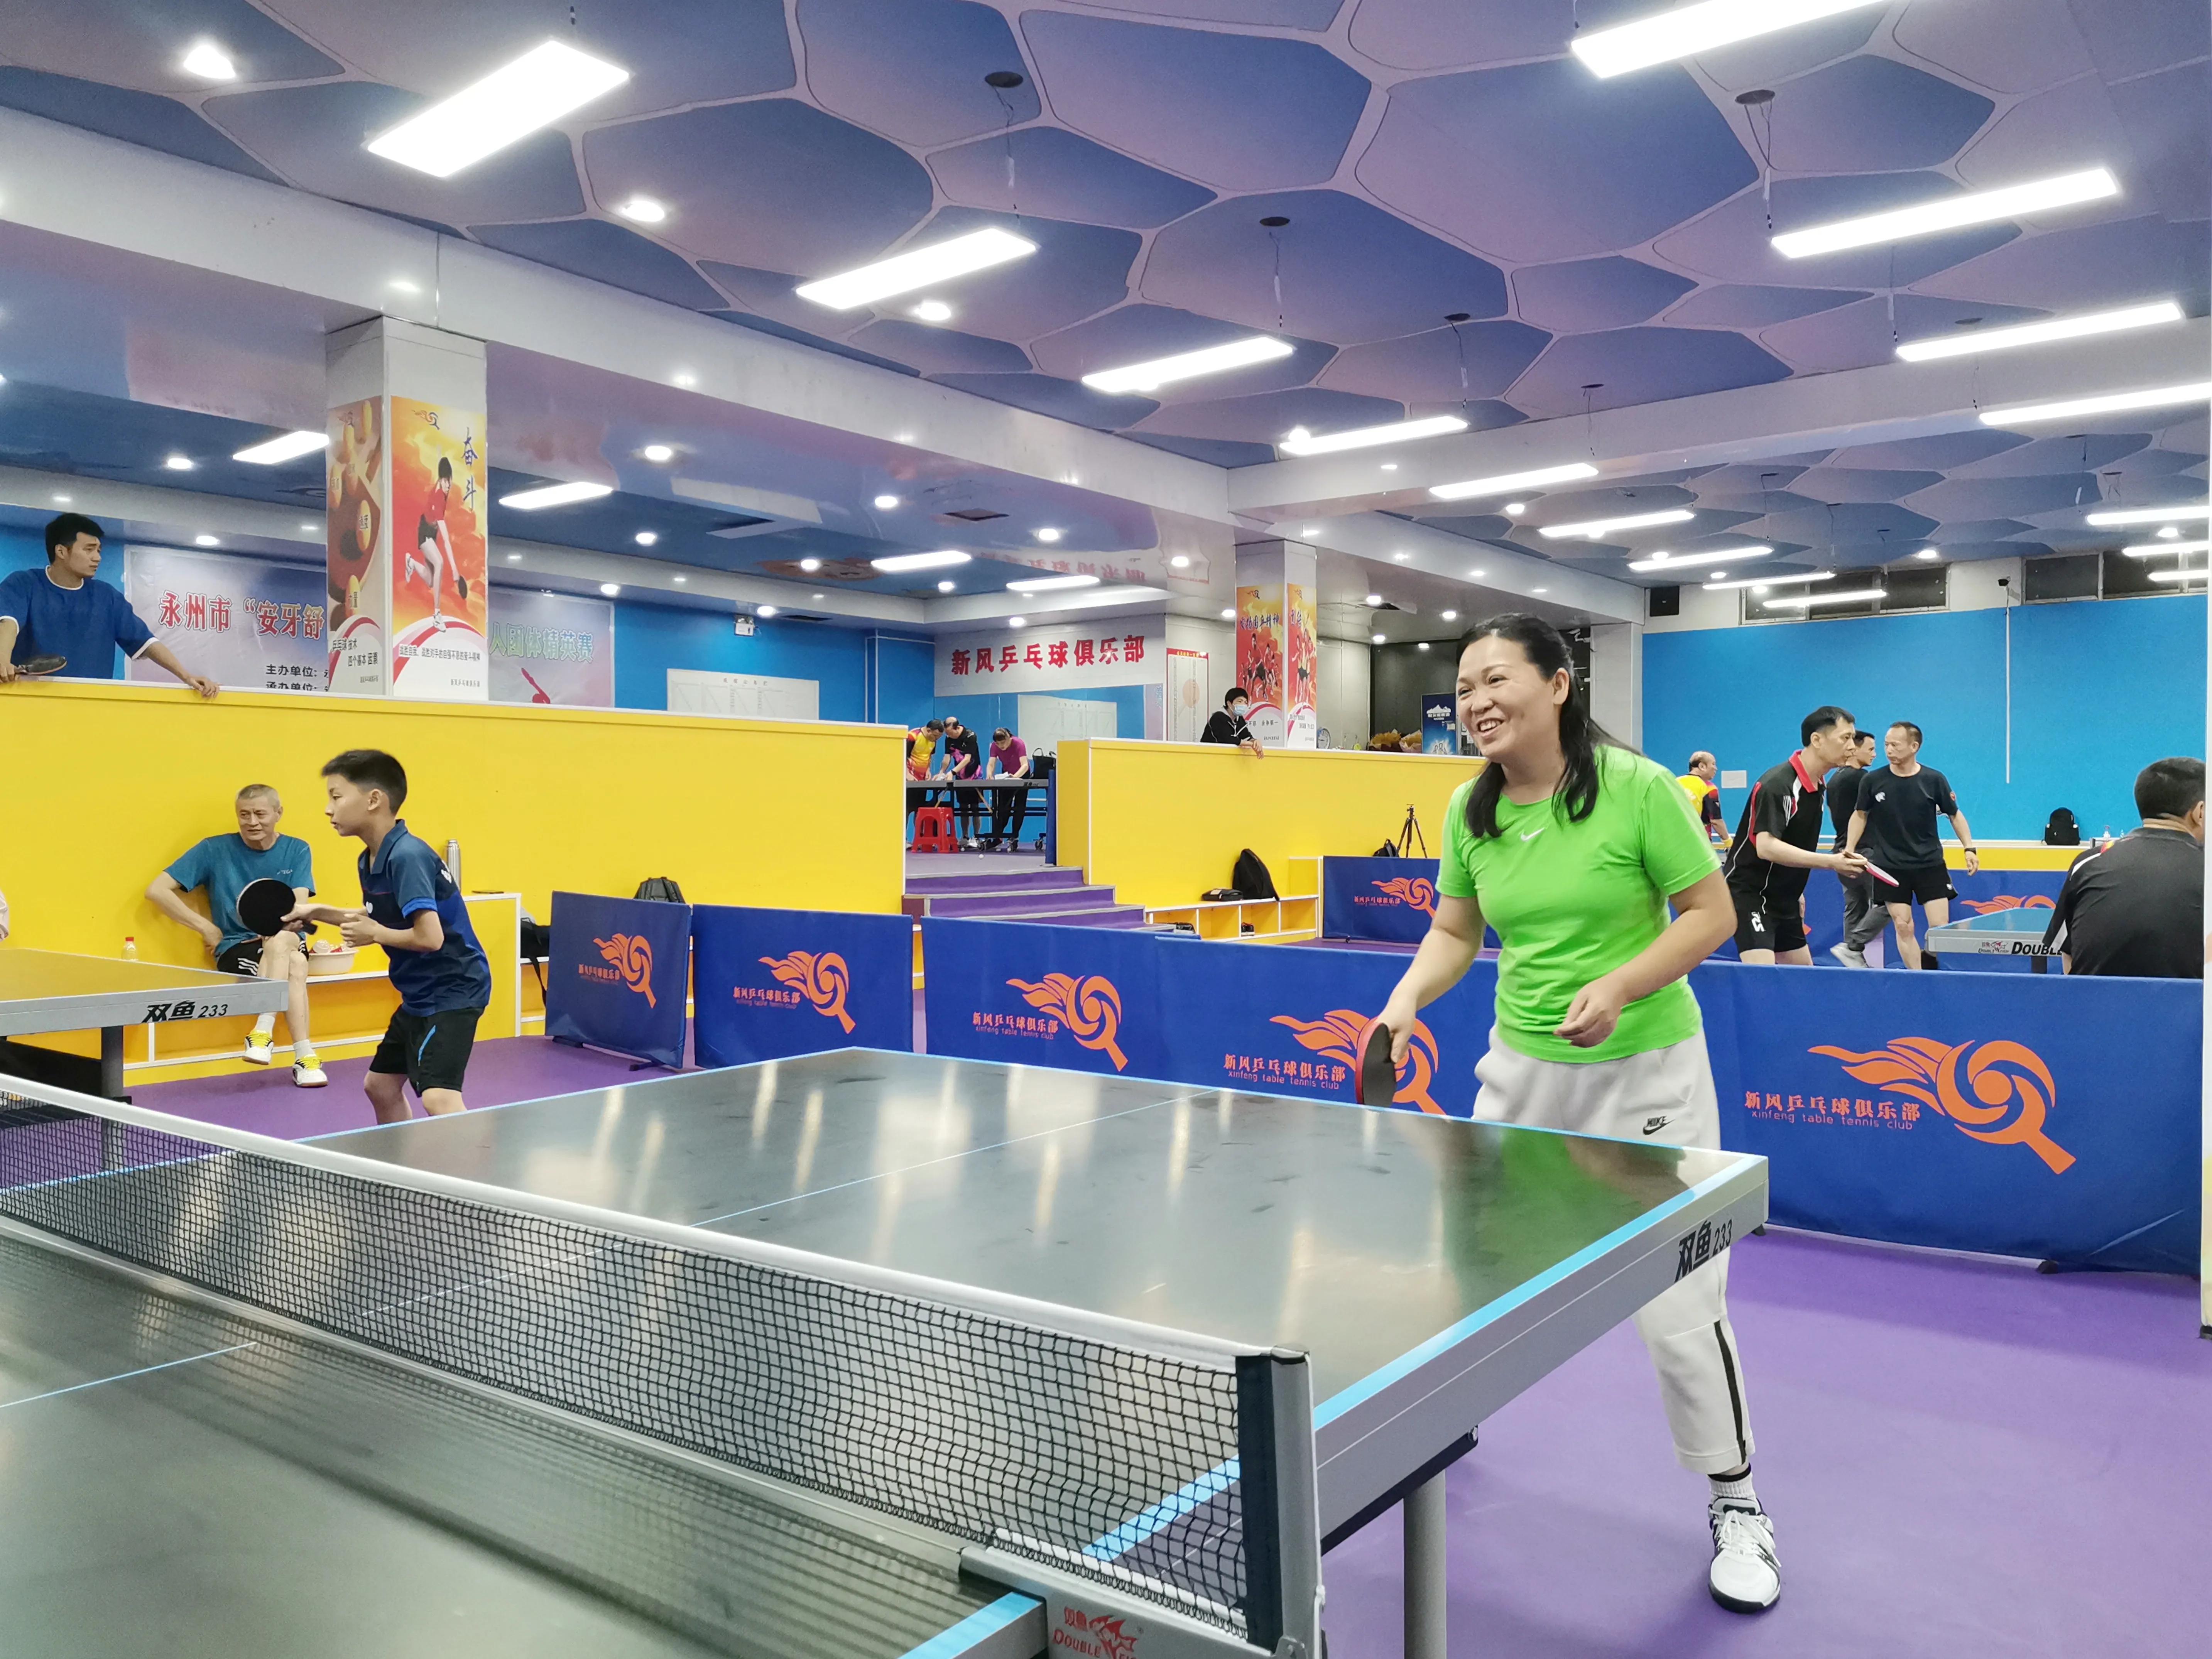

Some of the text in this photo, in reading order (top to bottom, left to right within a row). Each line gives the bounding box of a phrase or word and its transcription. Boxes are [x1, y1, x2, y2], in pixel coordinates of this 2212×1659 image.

[159, 590, 232, 632] 永州市
[488, 622, 593, 664] 人团体精英赛
[951, 635, 1146, 676] 新风乒乓球俱乐部
[141, 1000, 228, 1023] 双鱼 233
[973, 1012, 1058, 1033] 新风乒乓球俱乐部
[1223, 1053, 1346, 1081] 新风乒乓球俱乐部
[1229, 1070, 1339, 1090] xinfeng table tennis club
[1744, 1091, 1920, 1121] 新风乒乓球俱乐部
[1752, 1110, 1913, 1130] xinfeng table tennis club
[1674, 1218, 1732, 1283] 双鱼 233
[1053, 1629, 1101, 1658] DOUBLE
